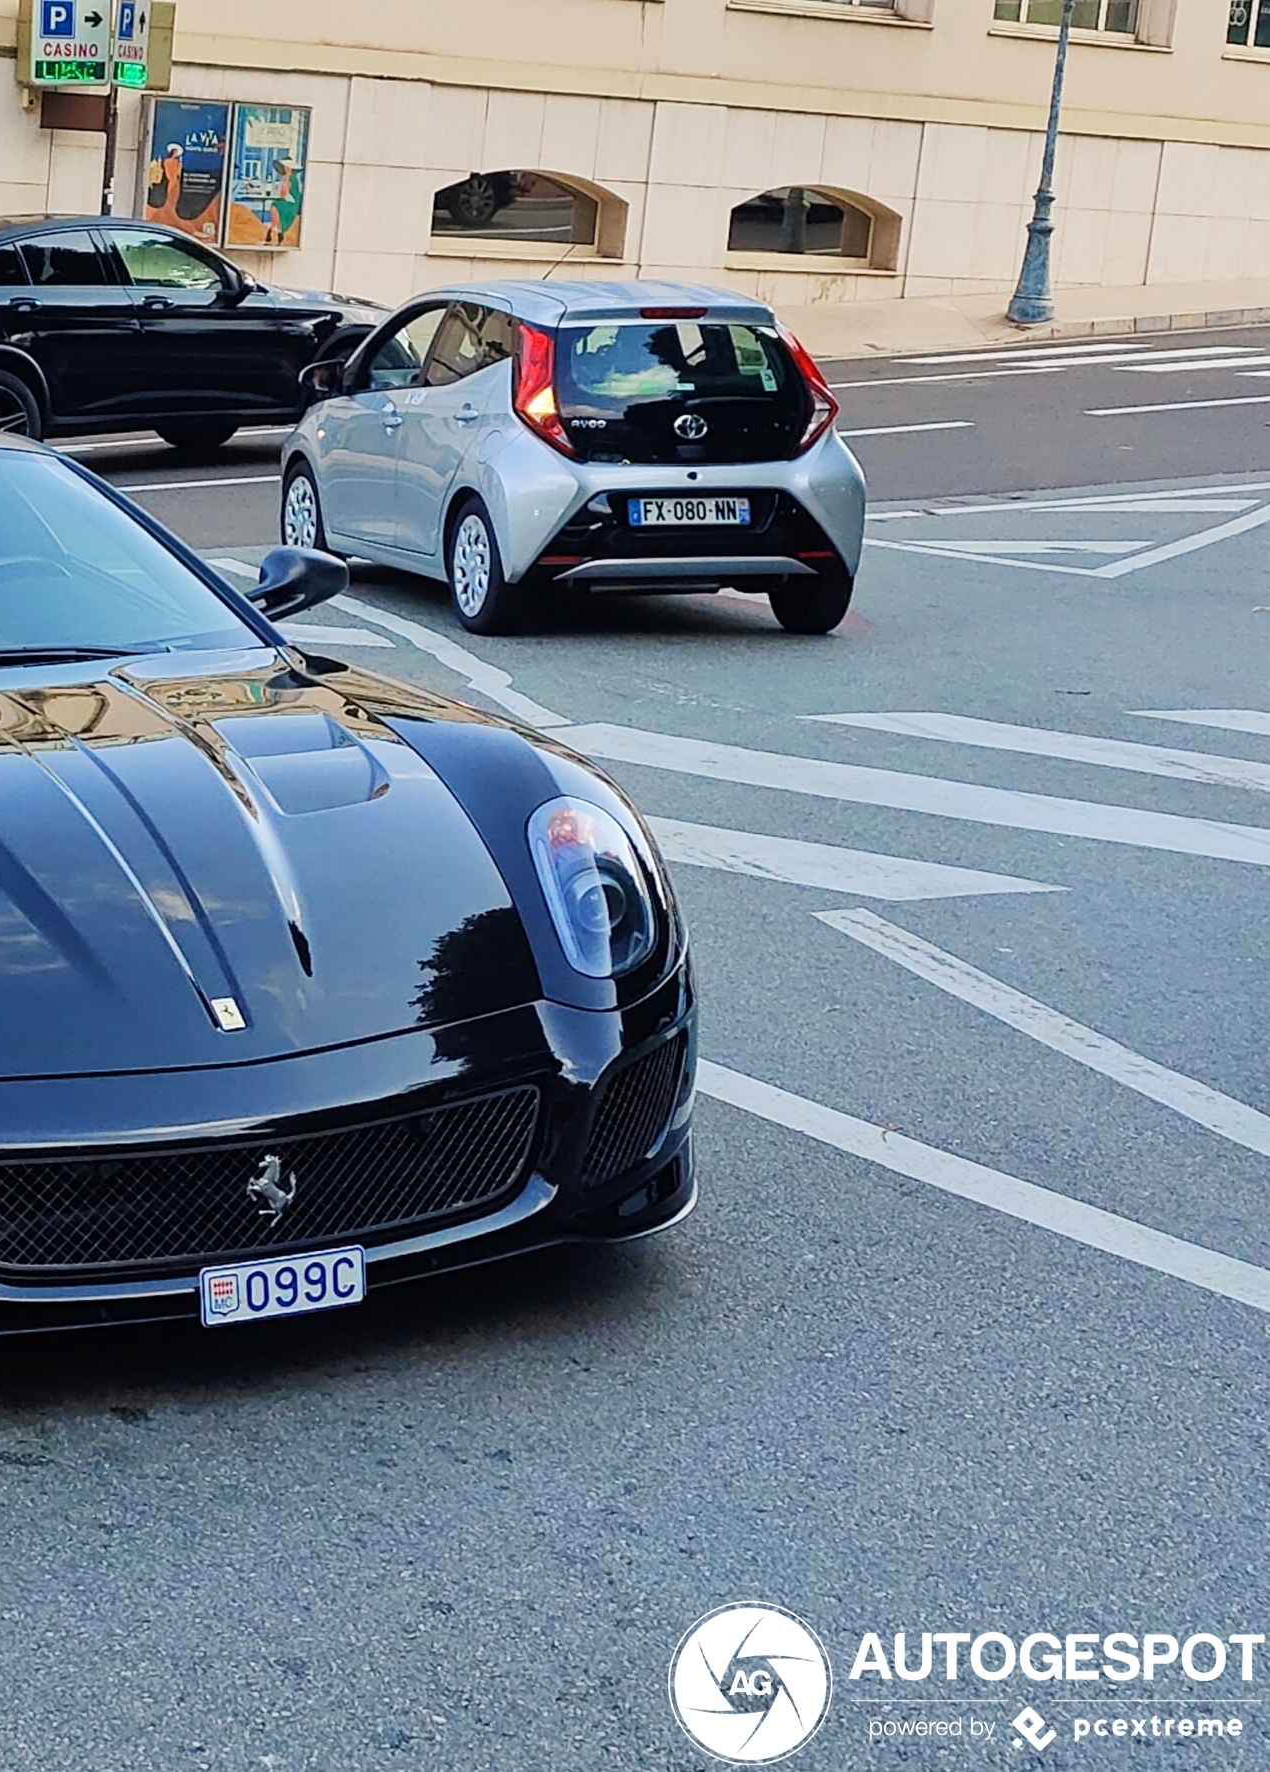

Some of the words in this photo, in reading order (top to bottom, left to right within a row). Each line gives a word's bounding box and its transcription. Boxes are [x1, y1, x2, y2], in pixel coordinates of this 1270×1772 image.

[43, 43, 98, 57] CASINO
[118, 45, 143, 60] CASINO
[186, 132, 198, 146] LA
[199, 129, 219, 147] VITA
[643, 500, 737, 522] FX-080-NN
[214, 1296, 233, 1310] MC
[246, 1257, 356, 1312] 099C
